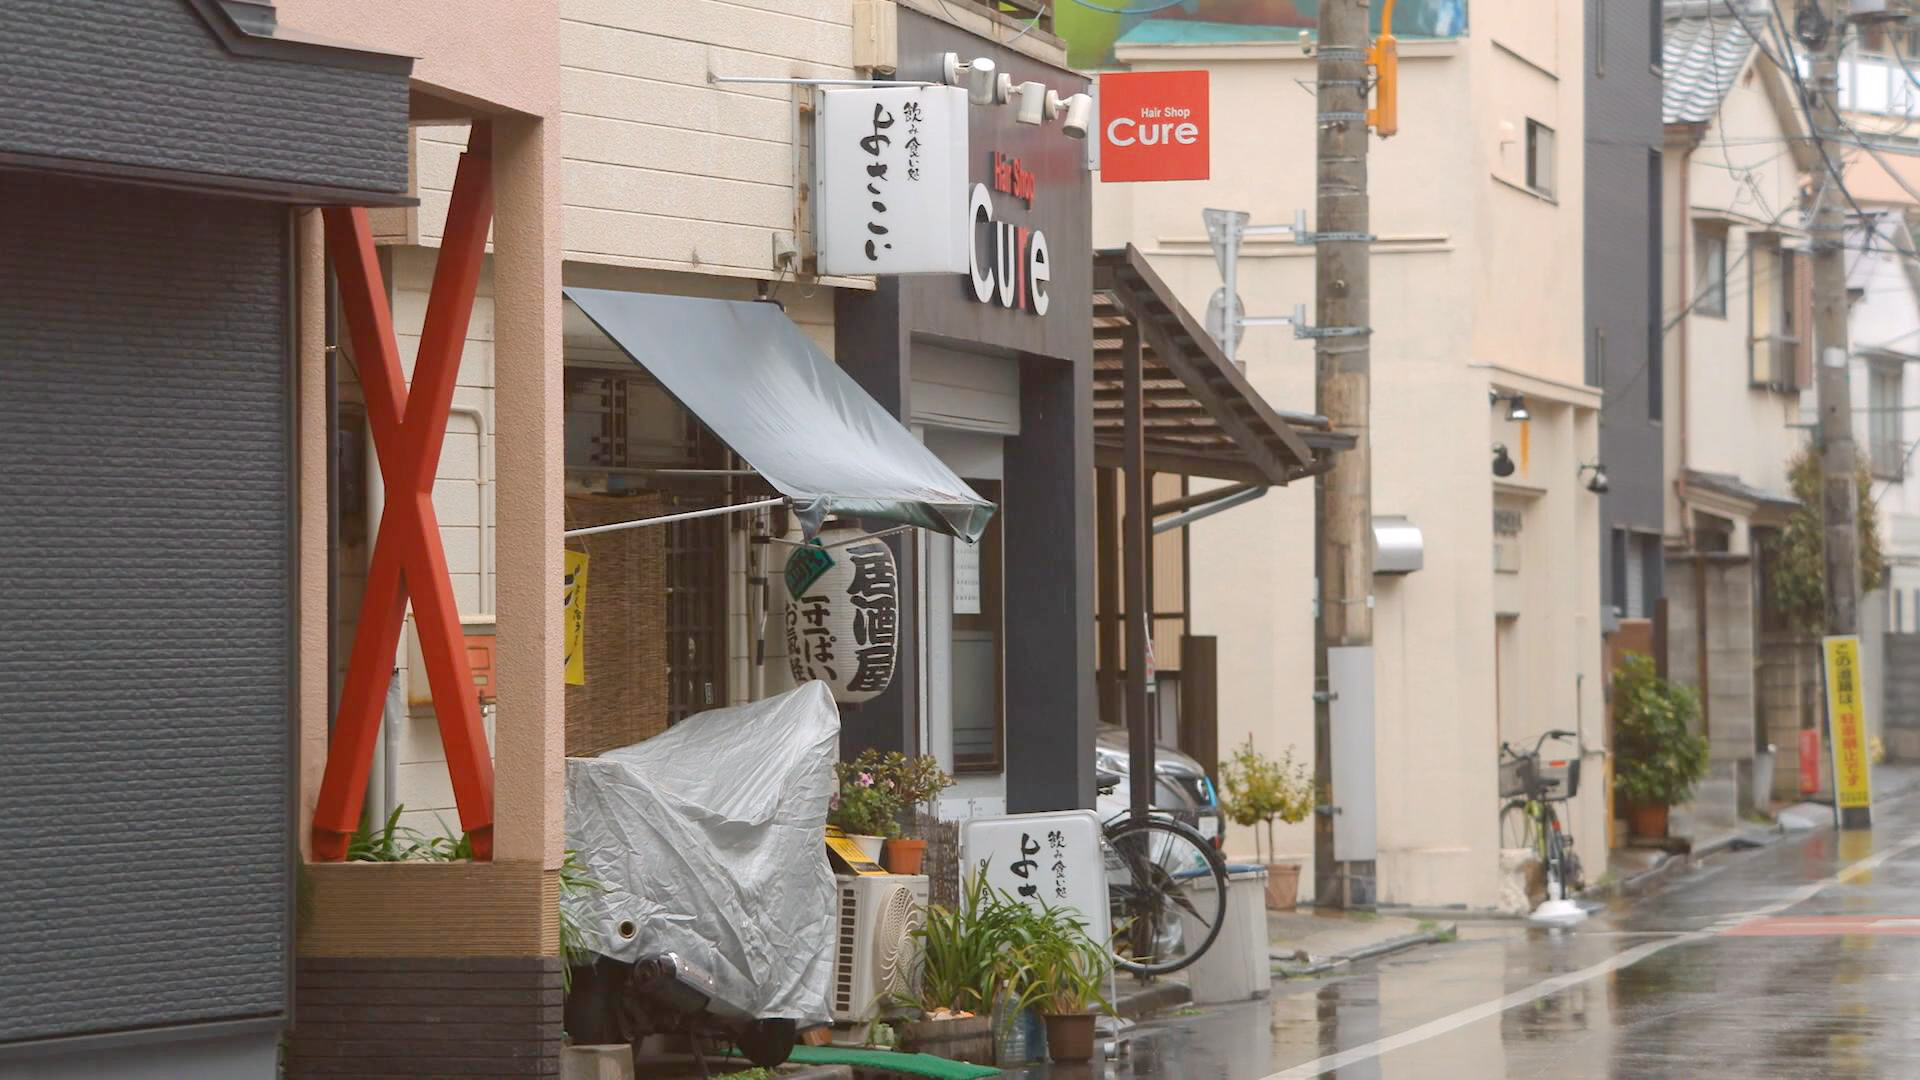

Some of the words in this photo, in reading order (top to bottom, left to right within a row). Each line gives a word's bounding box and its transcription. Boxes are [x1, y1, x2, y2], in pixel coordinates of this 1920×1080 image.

[903, 101, 923, 183] 飲み食い処
[1107, 117, 1199, 147] Cure
[1141, 107, 1161, 119] Hair
[1164, 106, 1191, 119] Shop
[993, 151, 1013, 193] Hair
[1013, 157, 1035, 210] Shop
[969, 182, 1050, 317] Cure
[846, 542, 898, 692] 居酒屋
[1048, 830, 1067, 899] 飲み食い処
